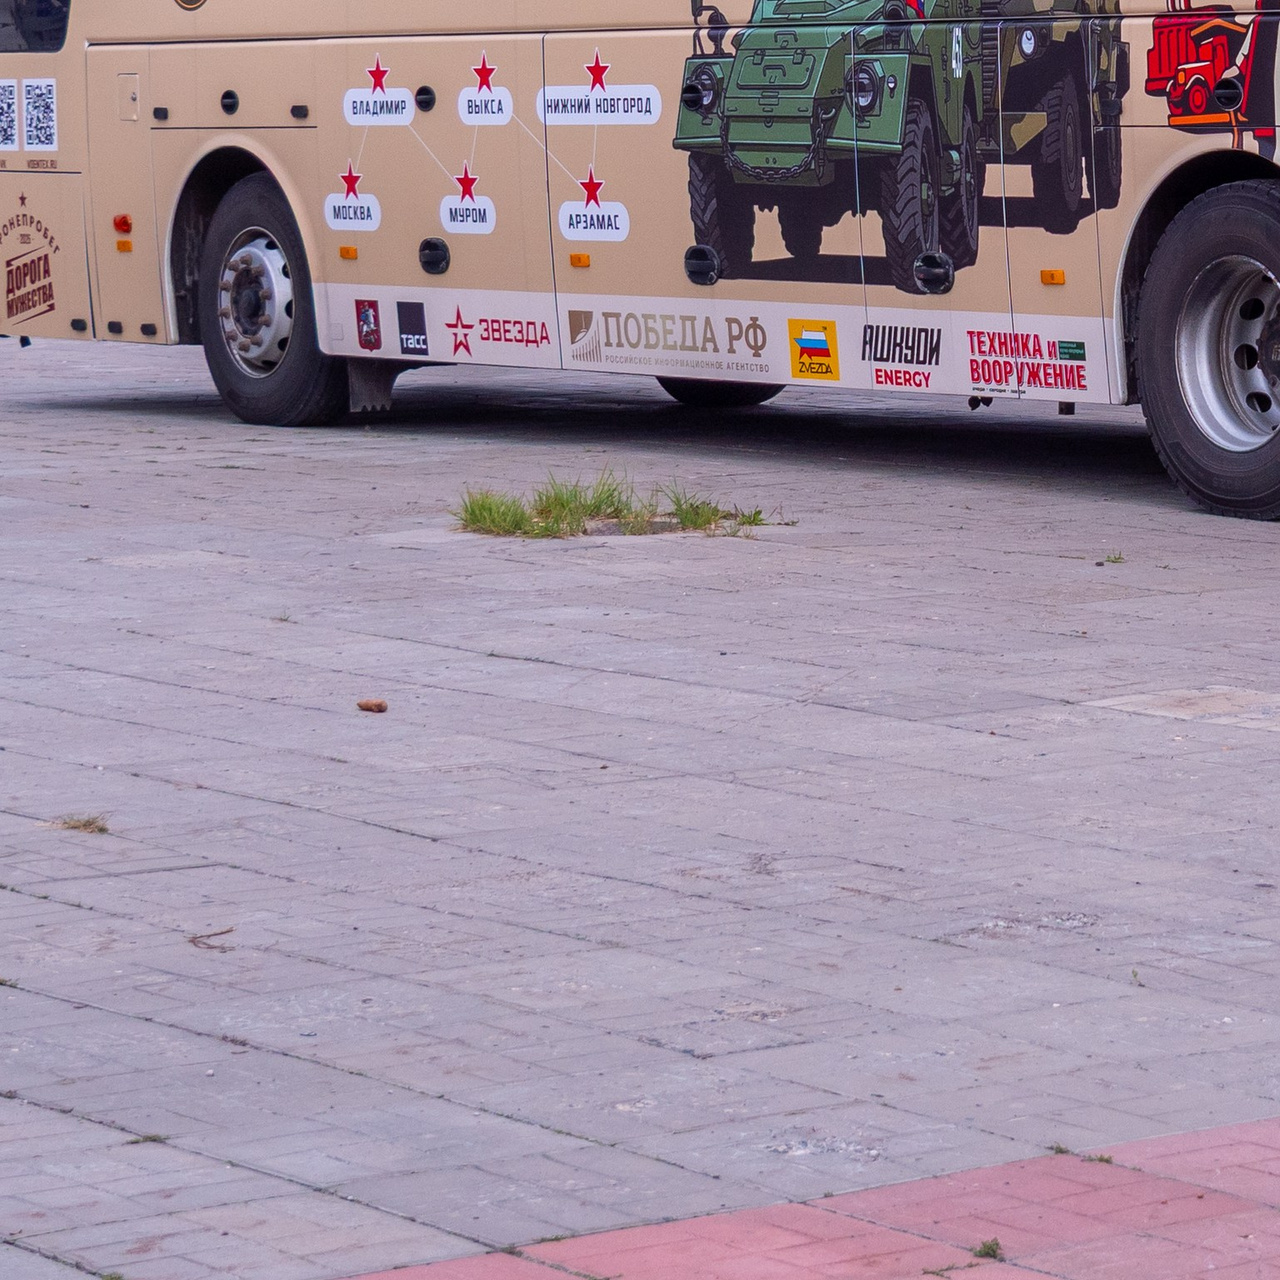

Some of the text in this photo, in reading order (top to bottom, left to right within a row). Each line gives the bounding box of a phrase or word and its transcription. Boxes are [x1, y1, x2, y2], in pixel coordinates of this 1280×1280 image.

[352, 99, 407, 116] ВЛАДИМИР
[467, 99, 504, 115] ВЫКСА
[546, 95, 653, 116] НИЖНИЙ НОВГОРОД
[333, 205, 373, 221] МОСКВА
[449, 207, 487, 223] МУРОМ
[568, 213, 621, 231] АРЗАМАС
[0, 213, 61, 254] ОНЕПРОБЕГ
[6, 253, 51, 300] ДОРОГА
[7, 282, 55, 319] МУЖЕСТВА
[479, 318, 551, 348] ЗВЕЗДА
[601, 311, 767, 358] ПОБЕДА РФ
[967, 330, 1044, 360] ТЕХНИКА
[605, 354, 770, 374] РОССИЙСКОЕ ИНФОРМАЦИОННОЕ АГЕНТСТВО
[799, 361, 834, 375] ZVEZDA
[875, 368, 931, 388] ENERGY
[969, 358, 1088, 391] ВООРУЖЕНИЕ
